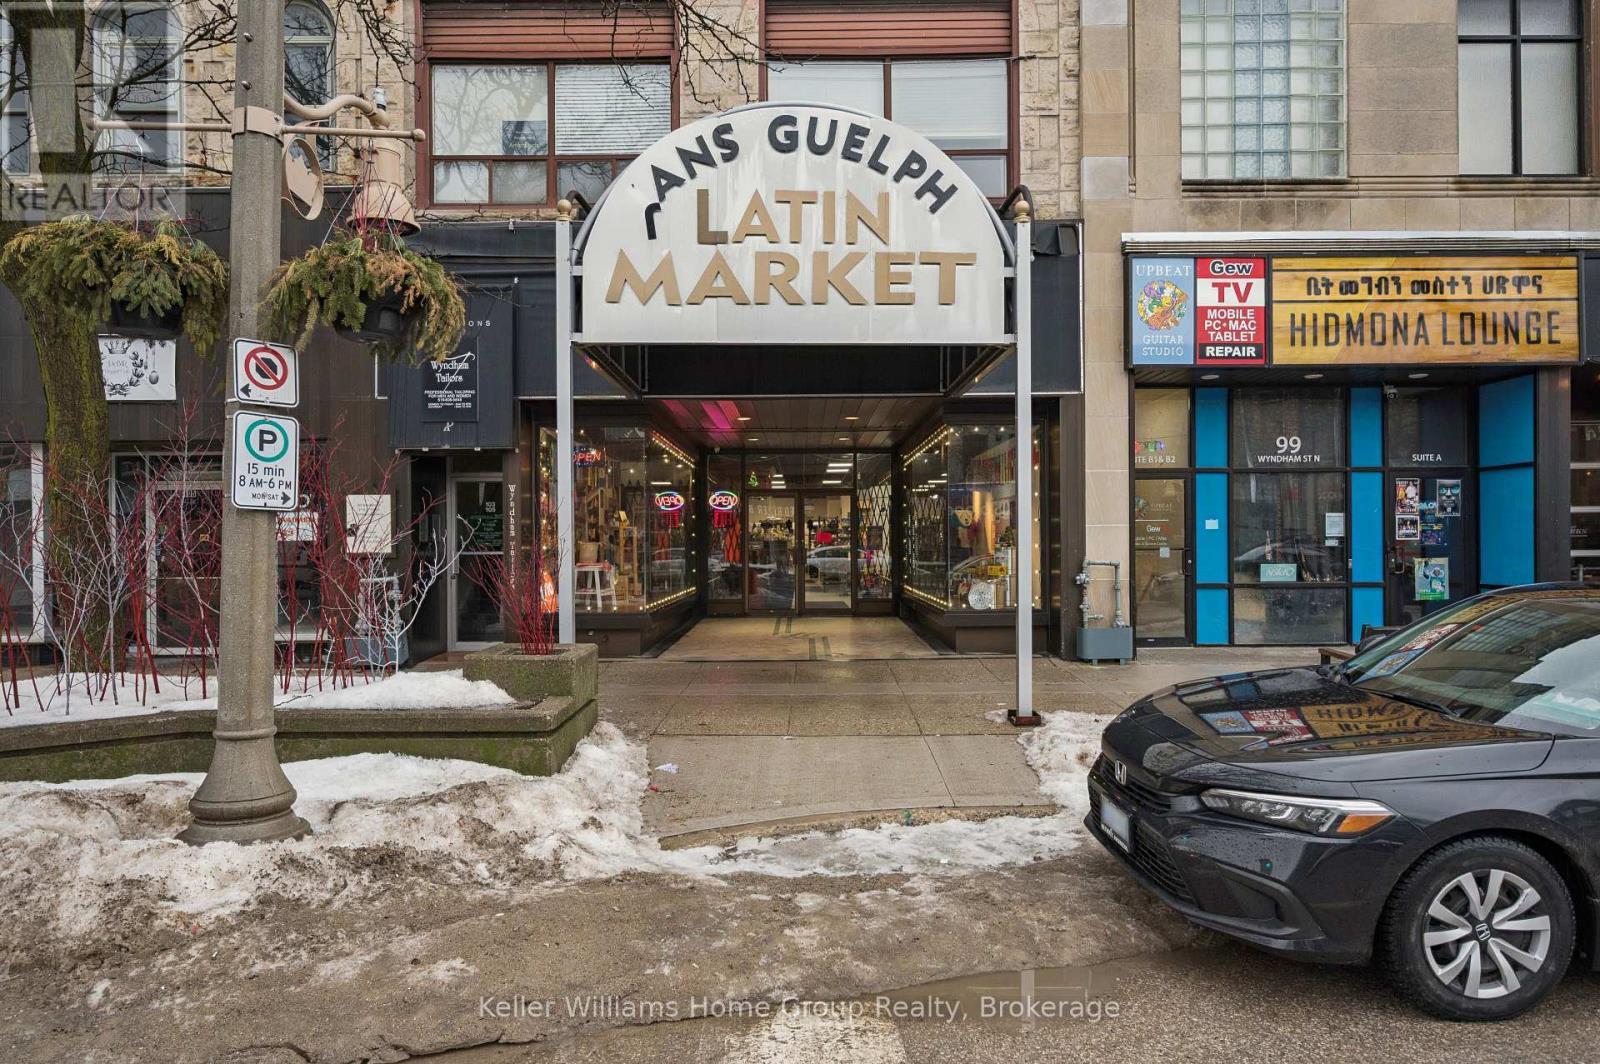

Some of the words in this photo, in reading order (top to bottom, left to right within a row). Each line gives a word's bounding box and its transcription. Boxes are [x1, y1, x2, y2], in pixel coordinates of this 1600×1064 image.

[767, 114, 958, 214] GUELPH
[696, 189, 890, 246] LATIN
[1136, 265, 1191, 277] UPBEAT
[1210, 259, 1253, 276] Gew
[605, 248, 977, 305] MARKET
[1211, 282, 1254, 304] TV
[1207, 309, 1255, 320] MOBILE
[1290, 312, 1430, 347] HIDMONA
[1442, 311, 1561, 346] LOUNGE
[1143, 335, 1184, 345] GUITAR
[1208, 331, 1256, 342] TABLET
[1142, 346, 1184, 356] STUDIO
[1206, 346, 1256, 357] REPAIR
[431, 360, 470, 372] Wyndham
[436, 373, 463, 383] Tailors
[258, 429, 278, 451] P
[1276, 436, 1301, 453] 99
[1257, 455, 1301, 463] WYNDHAM
[1412, 454, 1434, 462] SUITE
[1435, 454, 1442, 462] A
[247, 463, 258, 475] 15
[263, 464, 285, 477] min
[239, 475, 246, 487] 8
[278, 480, 292, 490] PM
[711, 496, 737, 507] OPEN
